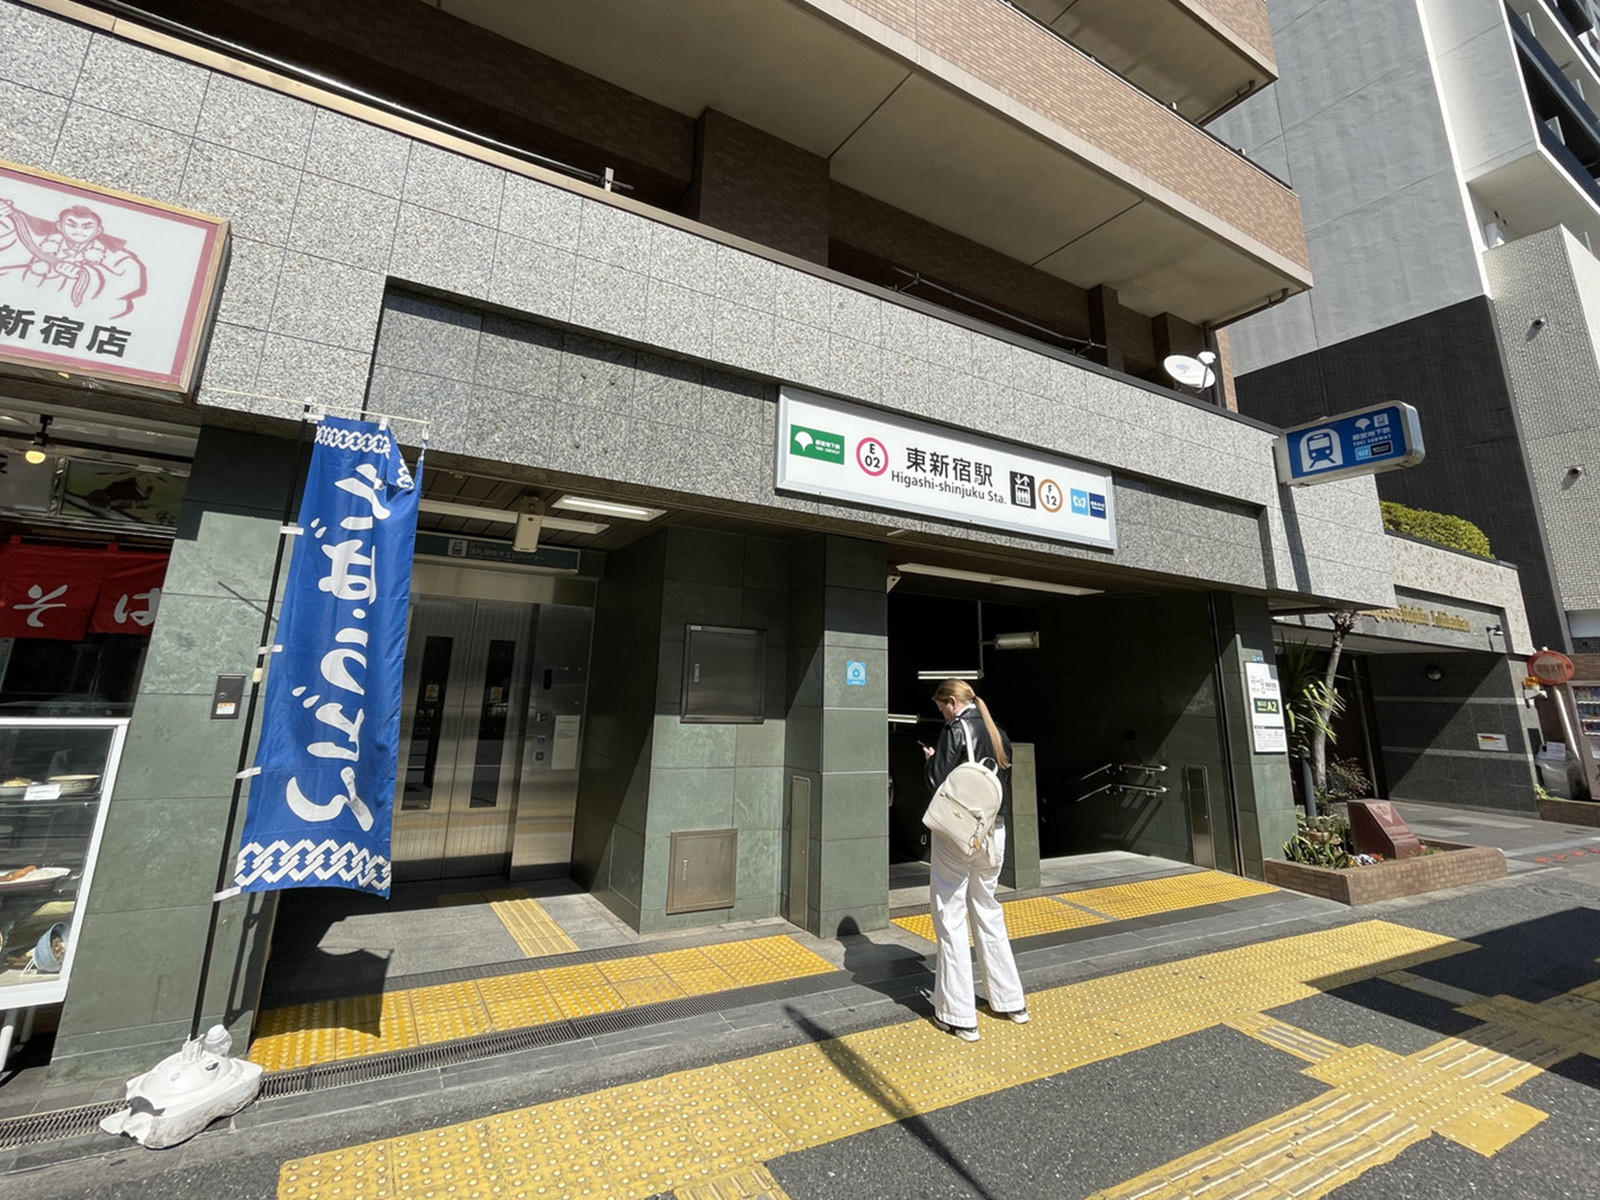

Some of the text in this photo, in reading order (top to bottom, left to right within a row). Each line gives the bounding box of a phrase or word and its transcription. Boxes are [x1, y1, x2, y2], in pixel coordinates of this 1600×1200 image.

[869, 443, 876, 454] E
[864, 455, 881, 468] 02
[905, 447, 993, 487] 東新宿駅
[891, 470, 1007, 504] Higashi-shinjuku Sta.
[1048, 485, 1053, 493] F
[1046, 494, 1057, 506] 12
[1268, 702, 1277, 712] A2
